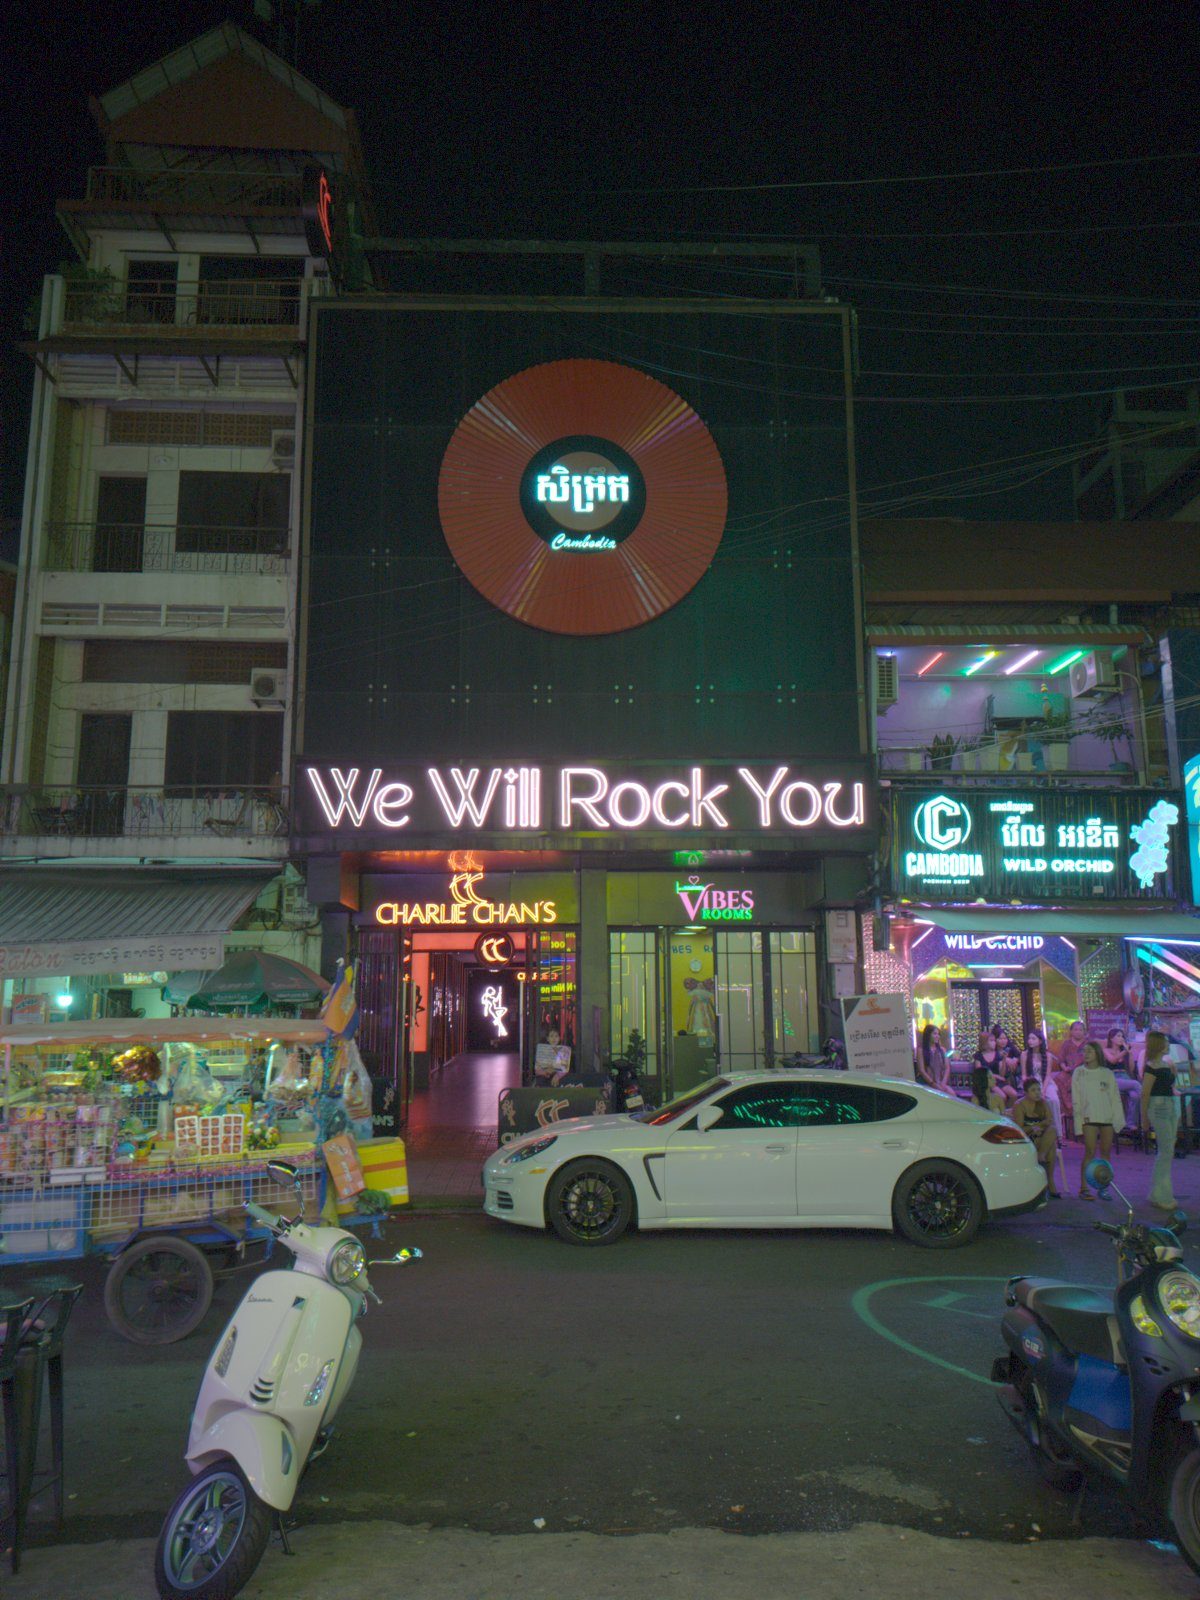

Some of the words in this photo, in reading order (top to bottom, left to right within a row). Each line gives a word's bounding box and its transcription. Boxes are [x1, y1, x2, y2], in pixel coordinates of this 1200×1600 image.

[551, 533, 616, 549] Cambodia
[307, 767, 413, 827] We
[428, 767, 540, 827] Will
[561, 767, 729, 827] Rock
[738, 766, 864, 827] You
[906, 852, 984, 877] CAMBODIA
[1003, 858, 1047, 872] WILD
[1050, 859, 1114, 873] ORCHID
[375, 902, 467, 924] CHARLIE
[473, 901, 557, 924] CHAN'S
[678, 883, 755, 921] VIBES
[702, 908, 752, 920] ROOMS
